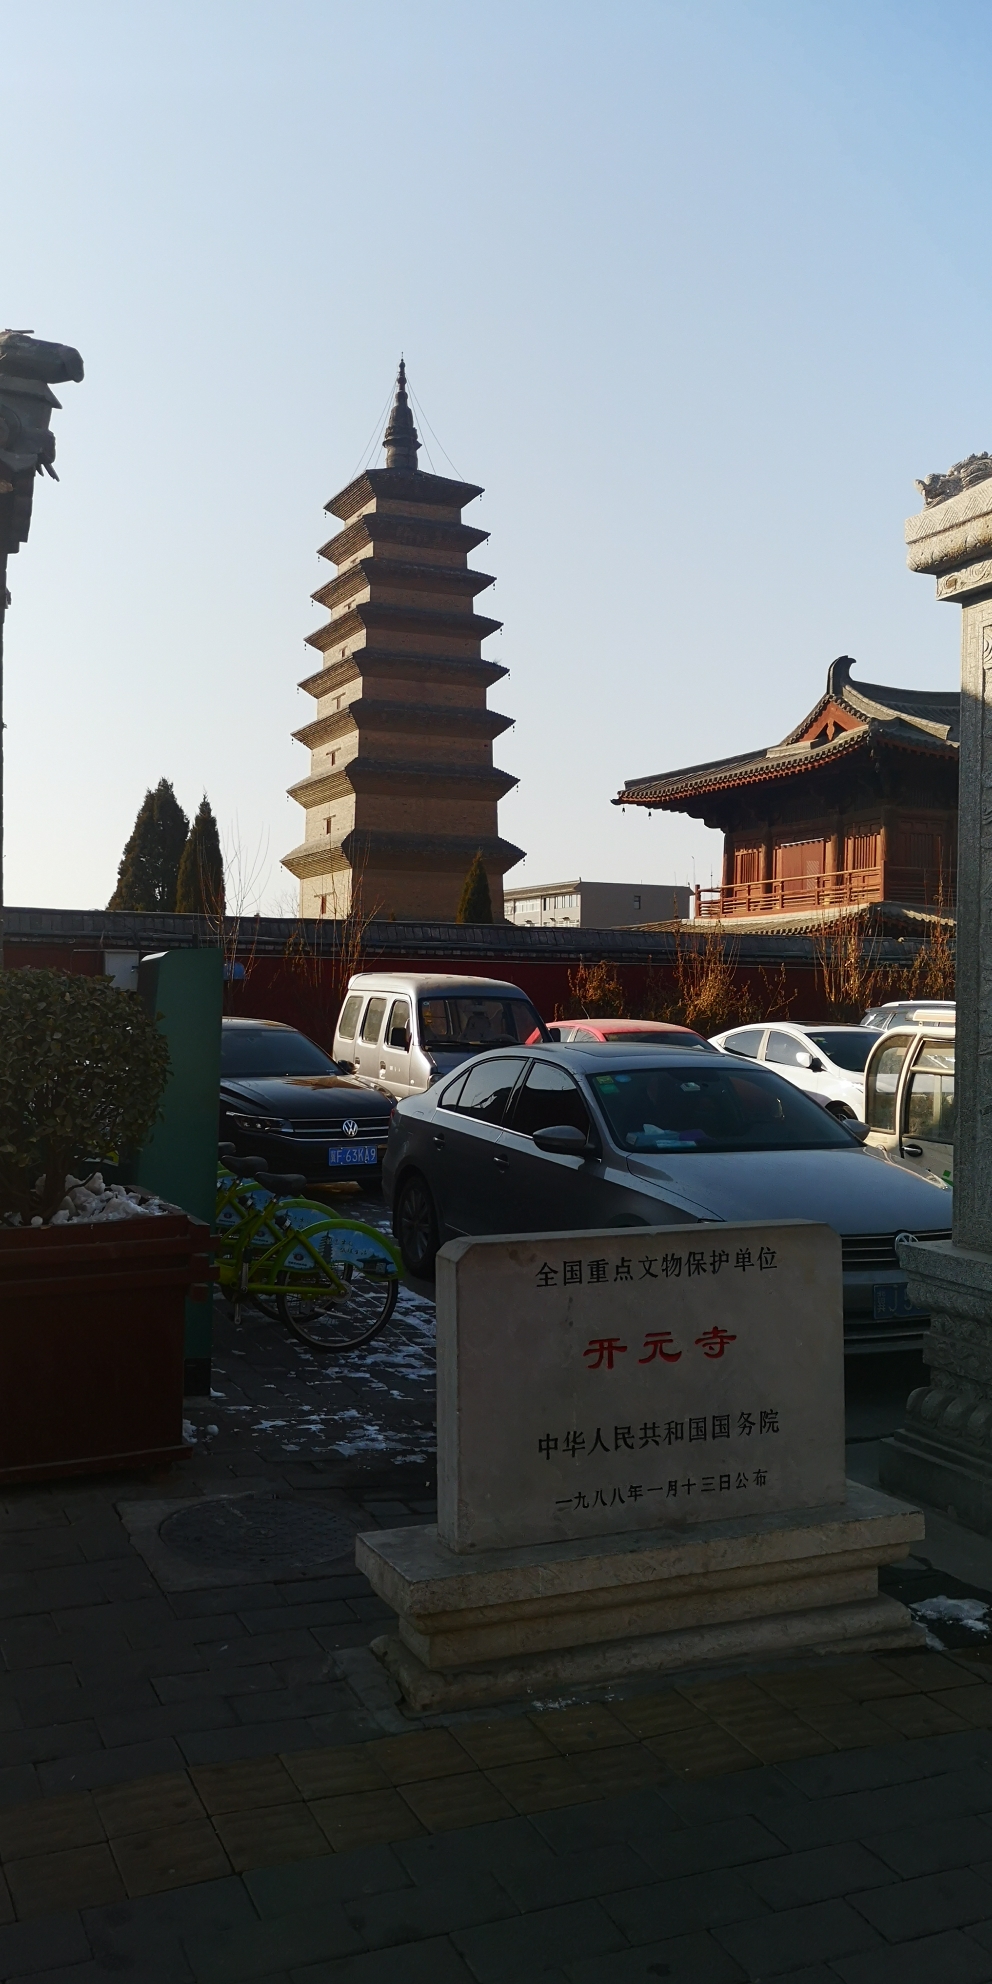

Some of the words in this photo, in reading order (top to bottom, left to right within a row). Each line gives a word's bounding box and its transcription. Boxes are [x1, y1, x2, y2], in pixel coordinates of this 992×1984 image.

[535, 1246, 778, 1288] 全国重点文物保护单位
[583, 1325, 737, 1370] 开元寺
[537, 1408, 780, 1461] 中华人民共和国国务院
[555, 1468, 769, 1510] 一九八八年一月十三日公布
